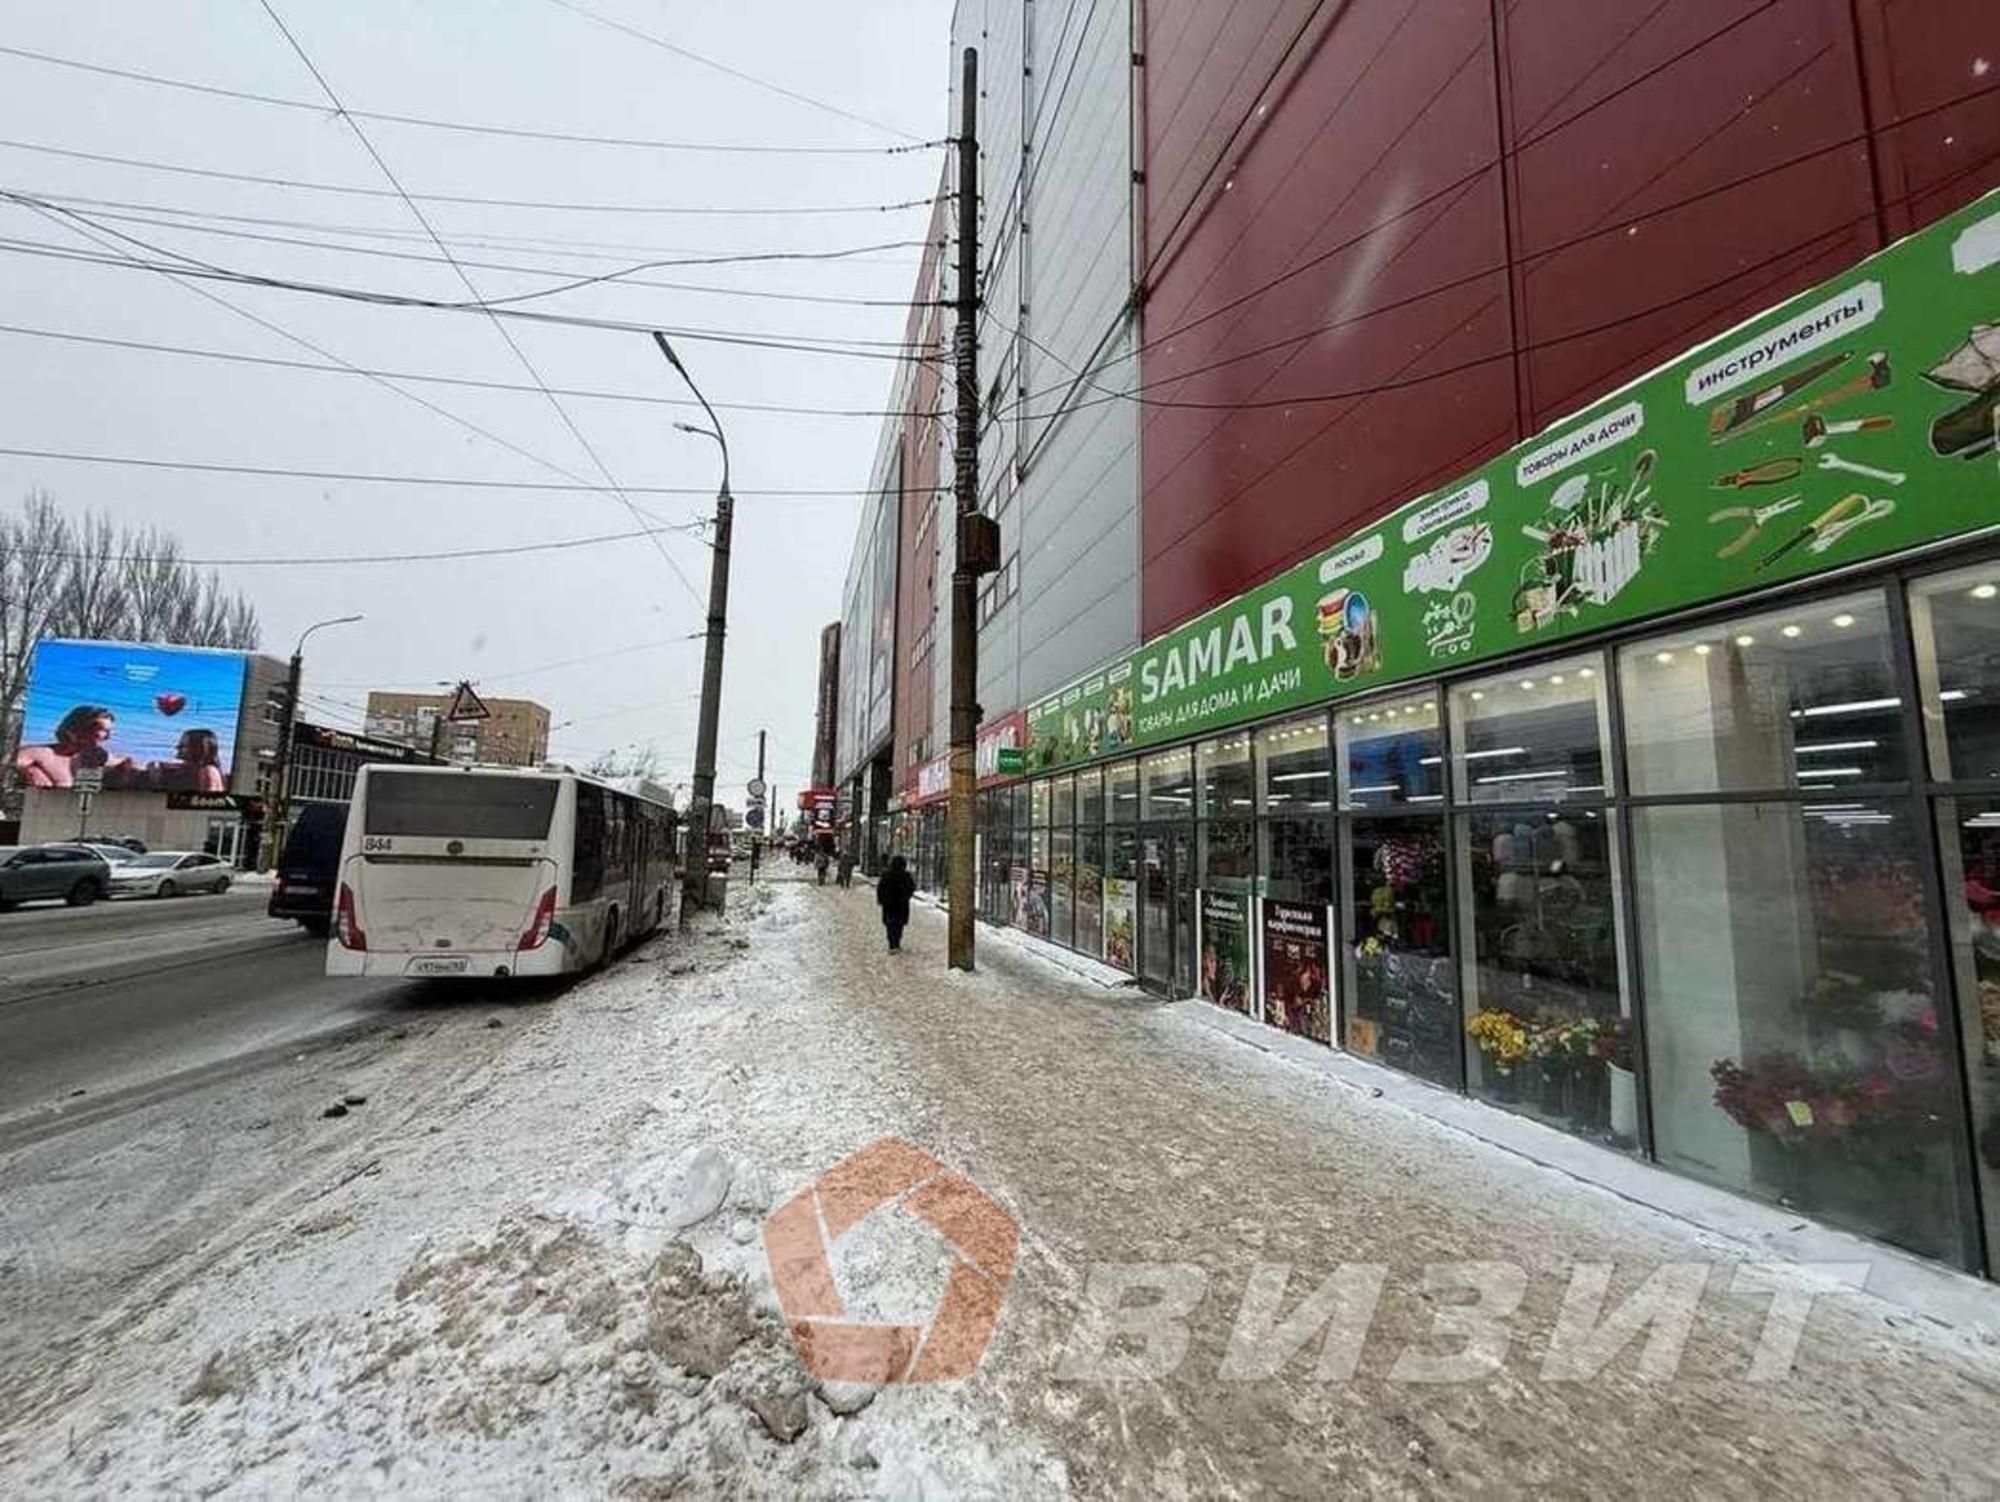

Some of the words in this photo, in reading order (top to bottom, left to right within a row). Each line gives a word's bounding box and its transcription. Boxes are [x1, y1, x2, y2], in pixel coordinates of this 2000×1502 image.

[1697, 298, 1864, 392] инструменты
[1570, 433, 1596, 457] для
[1598, 412, 1636, 442] дачи
[1140, 594, 1298, 705] SAMAR
[1175, 700, 1199, 725] ДЛЯ
[1199, 688, 1240, 718] ДОМА
[1242, 682, 1254, 703] И
[1256, 665, 1302, 702] ДАЧИ
